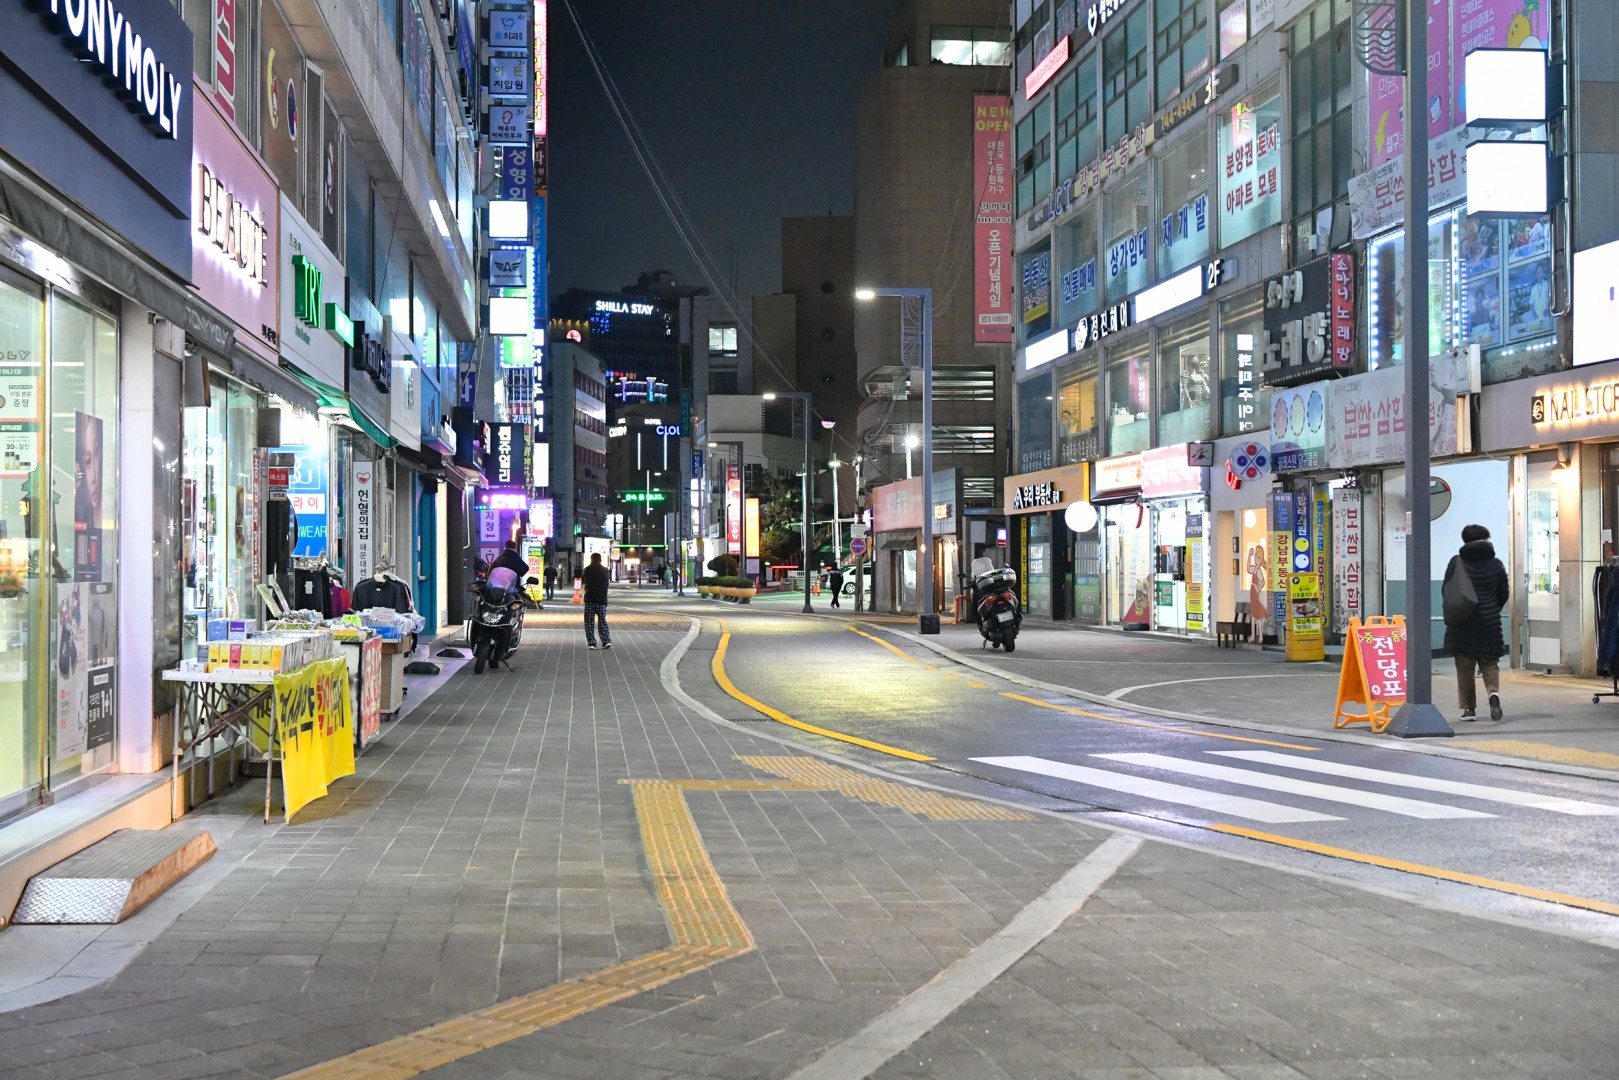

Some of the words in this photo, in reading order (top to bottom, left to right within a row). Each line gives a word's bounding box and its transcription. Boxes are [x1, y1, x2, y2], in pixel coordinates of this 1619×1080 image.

[494, 80, 523, 90] 지압원
[509, 149, 527, 200] 성형외
[1225, 139, 1254, 179] 분양권
[1257, 123, 1278, 159] 토지
[1047, 178, 1072, 221] LCT
[1225, 180, 1254, 214] 아파트
[1257, 166, 1278, 198] 모텔
[1023, 251, 1049, 294] 부동산
[1109, 226, 1148, 278] 상가임대
[1207, 258, 1221, 290] 2F
[292, 254, 323, 329] TRY
[596, 300, 629, 314] SHILLA
[630, 303, 654, 315] STAY
[1550, 391, 1585, 422] NAIL
[357, 489, 369, 540] 헌혈의집
[1023, 485, 1034, 507] 우리
[1035, 482, 1052, 506] 부동산
[1346, 508, 1359, 555] 보쌈
[1346, 561, 1360, 610] 삼합
[1363, 632, 1374, 644] 중
[1391, 631, 1401, 643] 동
[1372, 636, 1406, 696] 전당포
